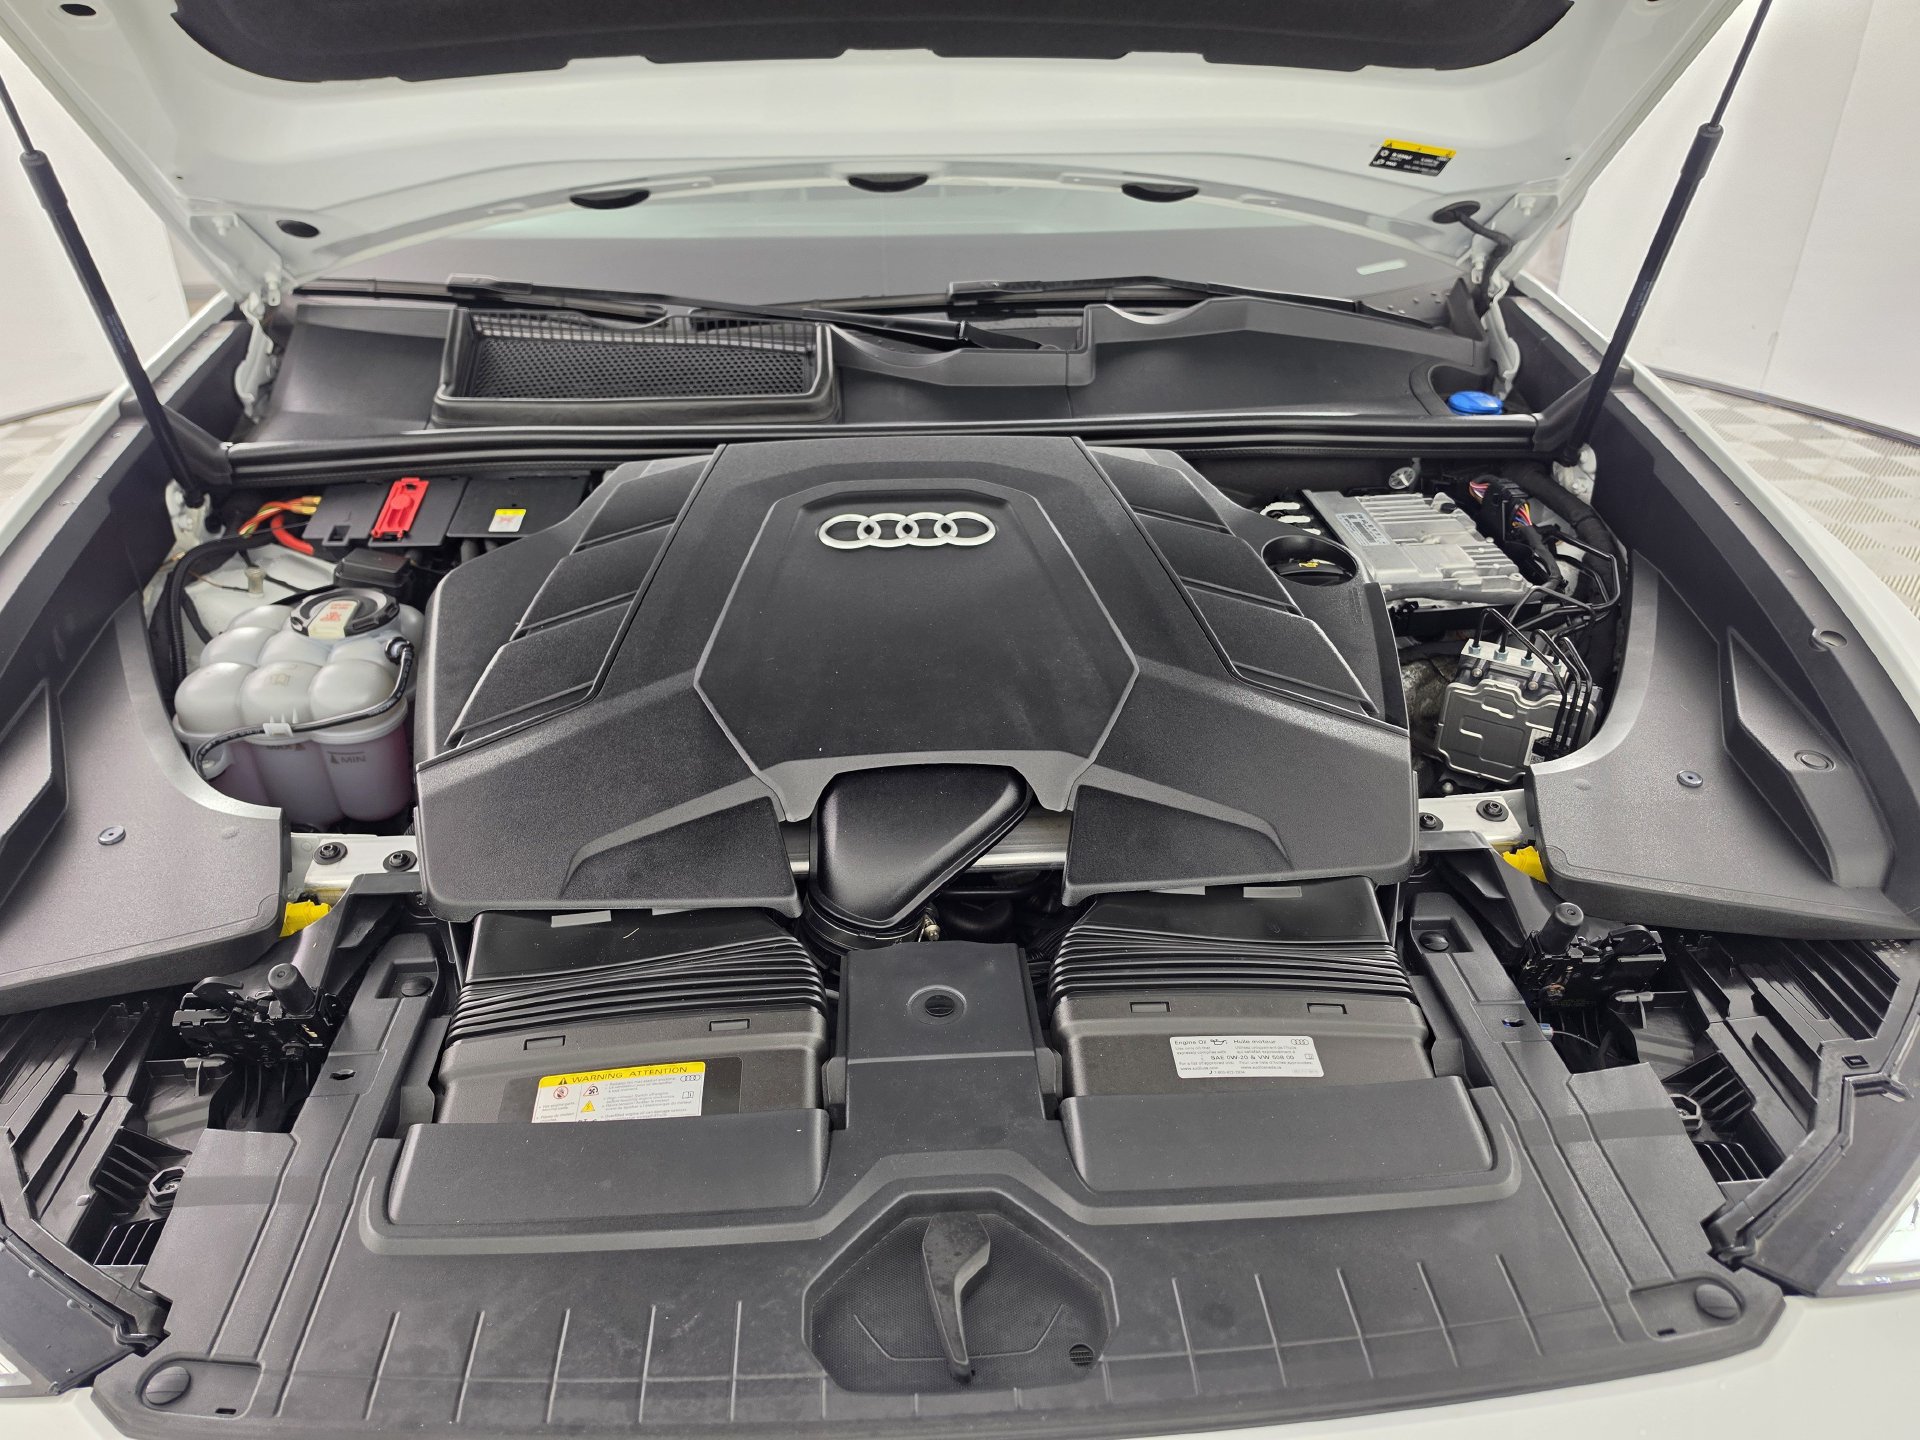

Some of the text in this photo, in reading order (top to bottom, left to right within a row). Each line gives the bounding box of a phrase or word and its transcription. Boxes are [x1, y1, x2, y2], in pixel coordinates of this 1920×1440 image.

[341, 756, 367, 764] MIN
[572, 1072, 623, 1083] WARNING
[629, 1066, 688, 1077] ATTENTION
